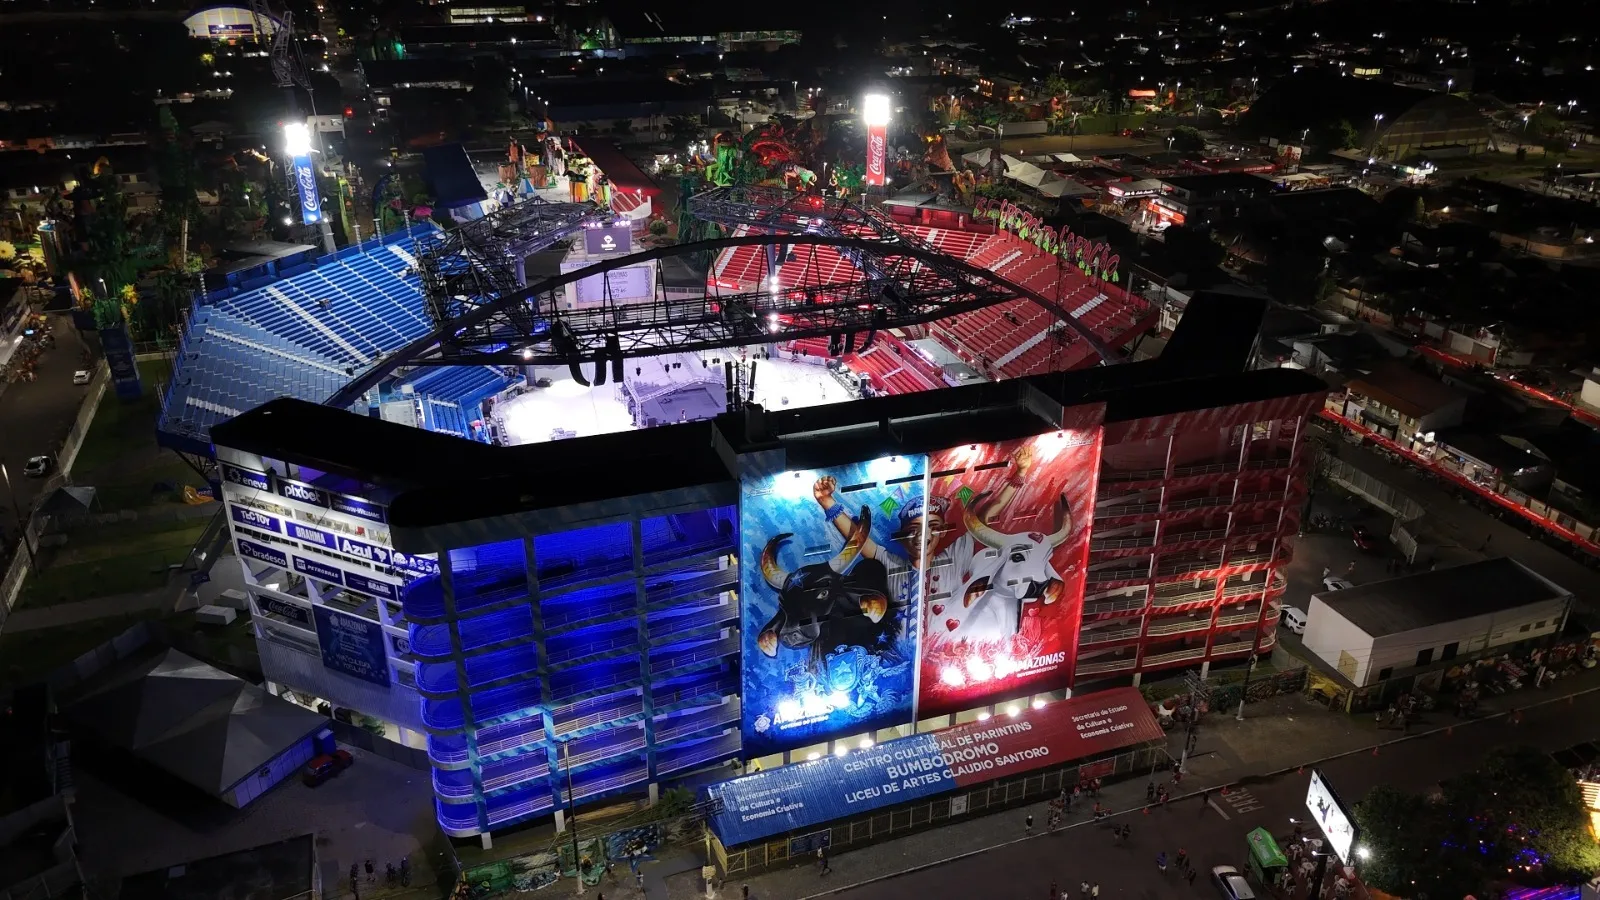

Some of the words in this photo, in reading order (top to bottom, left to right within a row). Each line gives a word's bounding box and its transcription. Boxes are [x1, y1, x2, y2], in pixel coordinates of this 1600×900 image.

[242, 477, 268, 490] eneva
[284, 484, 322, 503] pixbet
[295, 526, 327, 545] BRAHMA
[252, 549, 286, 566] bradesco
[342, 539, 373, 560] Azul
[307, 564, 339, 579] PETROBRAS
[1071, 711, 1100, 722] Secretaria
[1108, 705, 1128, 714] Estado
[1080, 727, 1110, 739] Economia
[1110, 721, 1134, 732] Criativa
[1085, 718, 1107, 728] Cultura
[843, 753, 892, 773] CENTRO
[894, 738, 957, 760] CULTURAL
[957, 734, 974, 747] DE
[974, 721, 1032, 743] PARINTINS
[844, 787, 881, 804] LICEU
[883, 783, 900, 794] DE
[902, 772, 941, 791] ARTES
[942, 760, 994, 778] CLAUDIO
[995, 746, 1050, 767] SANTORO
[739, 804, 749, 812] de
[750, 798, 775, 809] Cultura
[741, 808, 776, 822] Economia
[776, 802, 804, 813] Criativa
